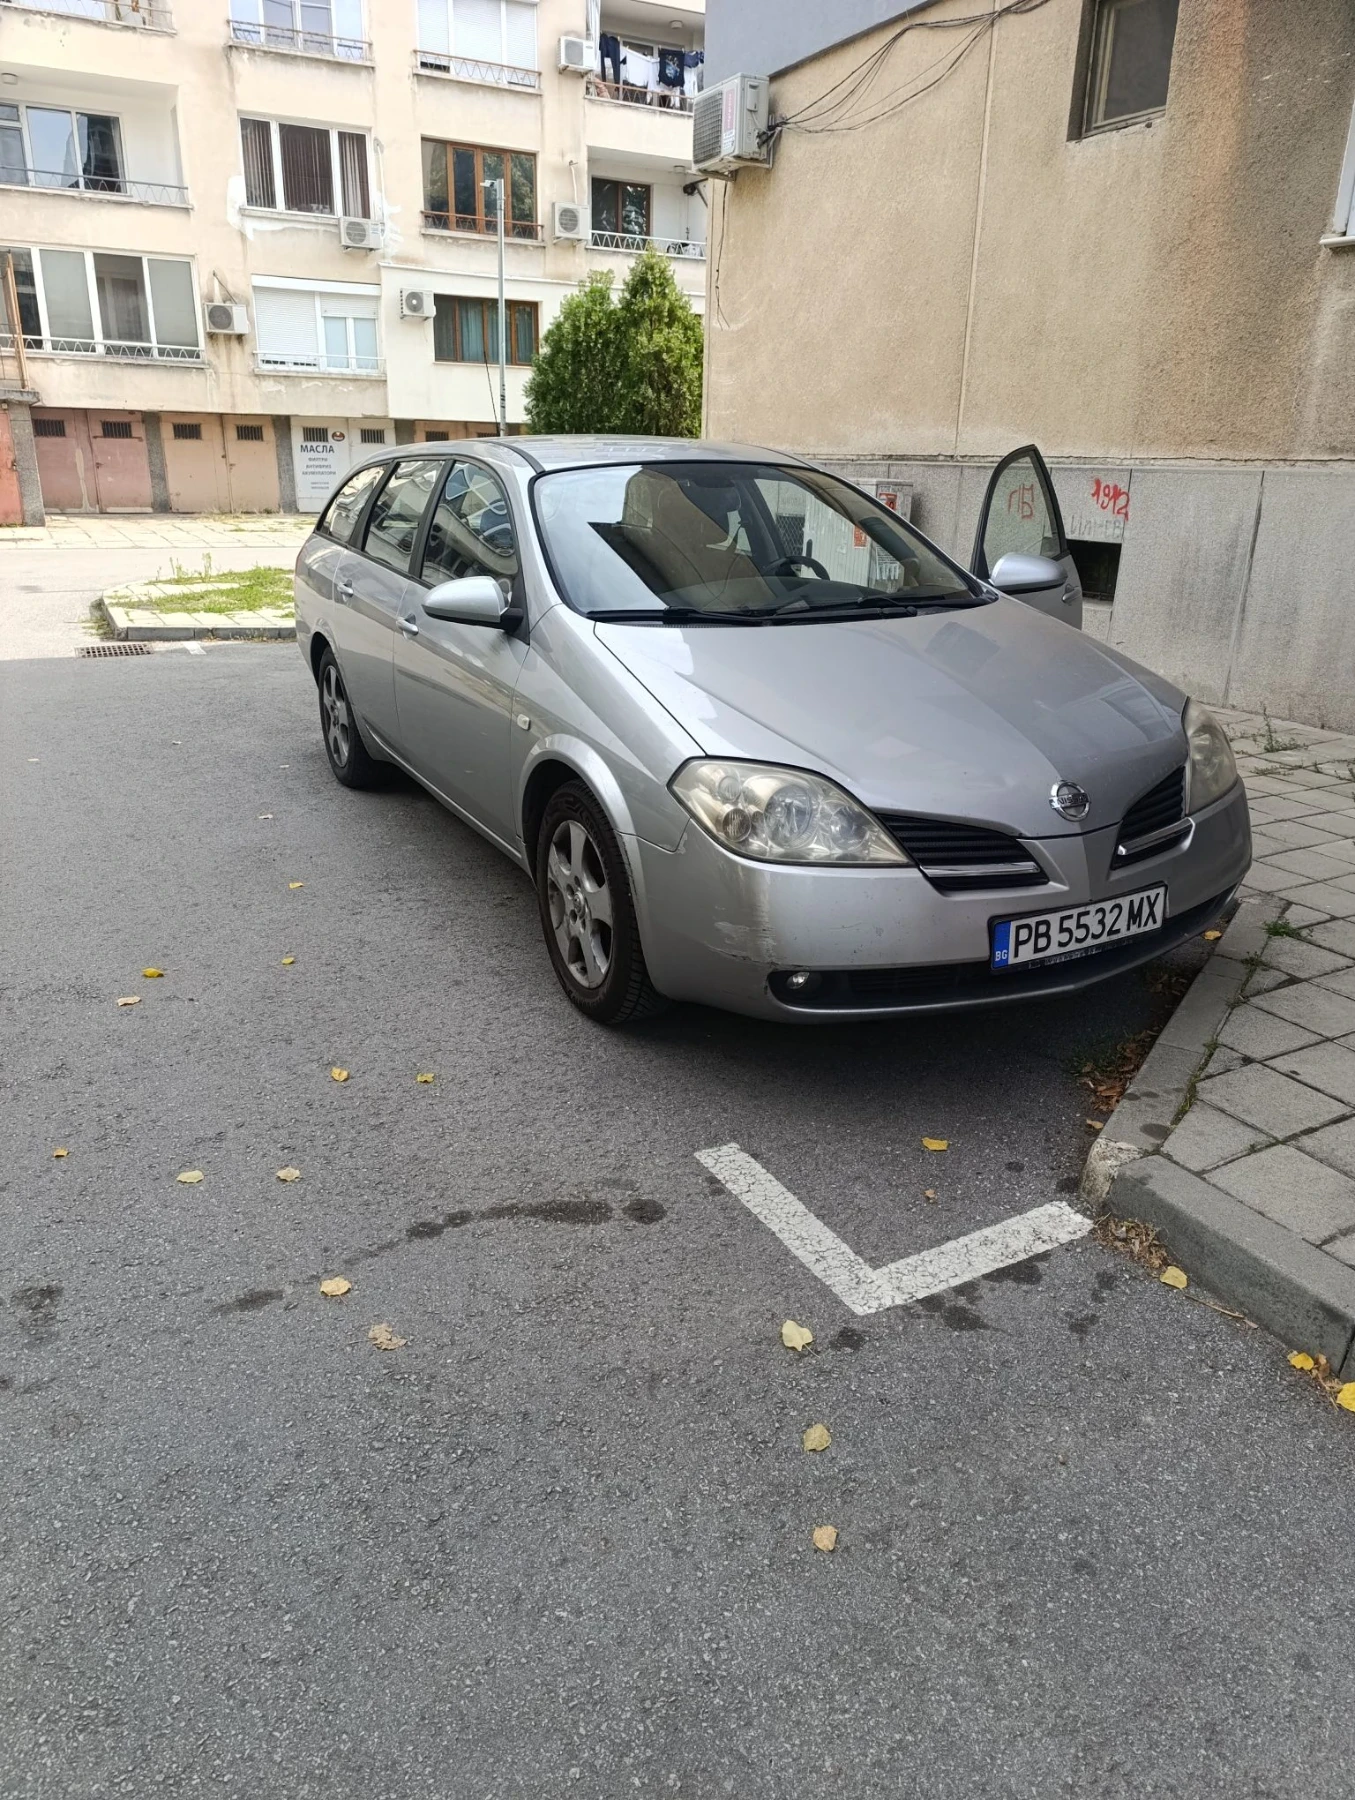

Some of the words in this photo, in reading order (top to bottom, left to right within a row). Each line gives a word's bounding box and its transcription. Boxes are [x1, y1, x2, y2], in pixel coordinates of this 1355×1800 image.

[300, 444, 335, 454] МАСЛА
[1091, 477, 1130, 522] 1912
[1013, 919, 1052, 959] PB
[1057, 902, 1123, 948] 5532
[1126, 892, 1161, 932] MX
[994, 950, 1008, 962] BG
